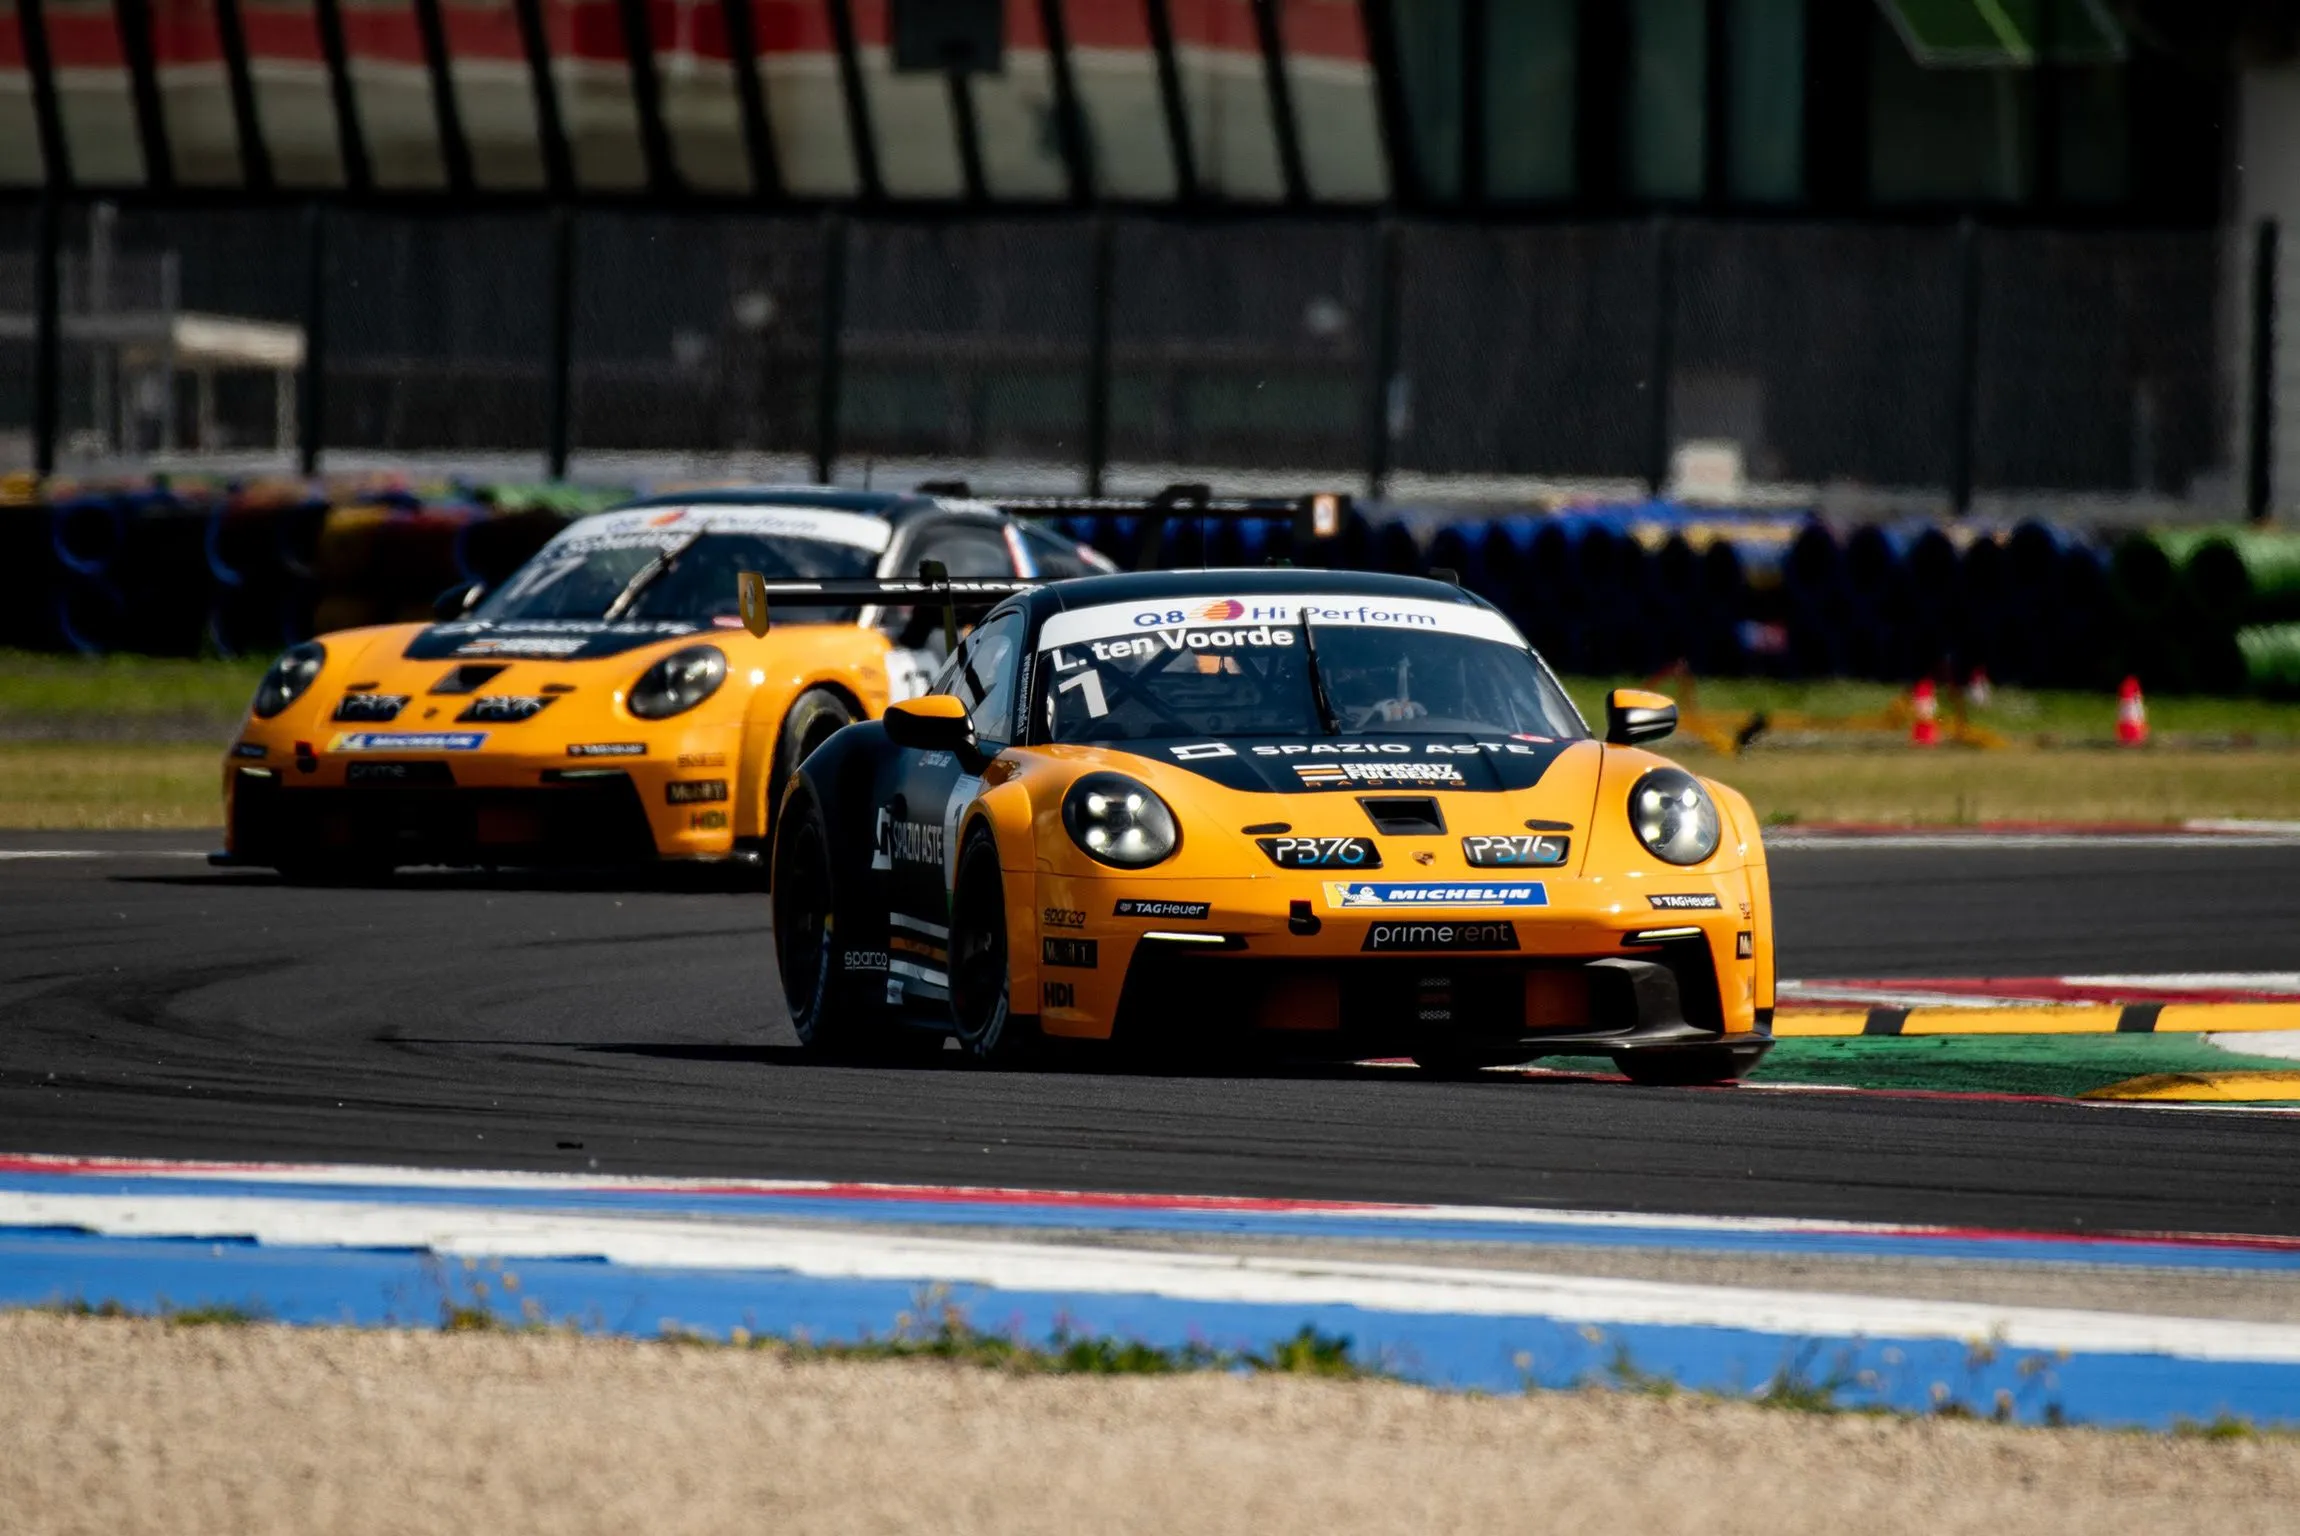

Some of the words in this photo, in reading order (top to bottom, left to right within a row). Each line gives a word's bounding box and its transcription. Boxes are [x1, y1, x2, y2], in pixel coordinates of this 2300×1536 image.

[1133, 610, 1186, 628] Q8
[1252, 607, 1287, 620] Hi
[1305, 606, 1437, 626] Perform
[1051, 648, 1088, 672] L.
[1091, 636, 1155, 661] ten
[1157, 626, 1295, 651] Voorde
[1057, 668, 1109, 719] 1
[1251, 743, 1412, 756] SPAZIO
[1425, 742, 1535, 755] ASTE
[1305, 779, 1467, 788] RACING
[921, 824, 944, 865] ASTE
[1276, 837, 1365, 864] P376
[1468, 836, 1558, 863] P376
[1388, 888, 1532, 900] MICHELIN
[1043, 908, 1087, 926] sparco
[1373, 923, 1509, 947] primerent
[844, 950, 888, 970] sparco
[1043, 982, 1076, 1008] HDI
